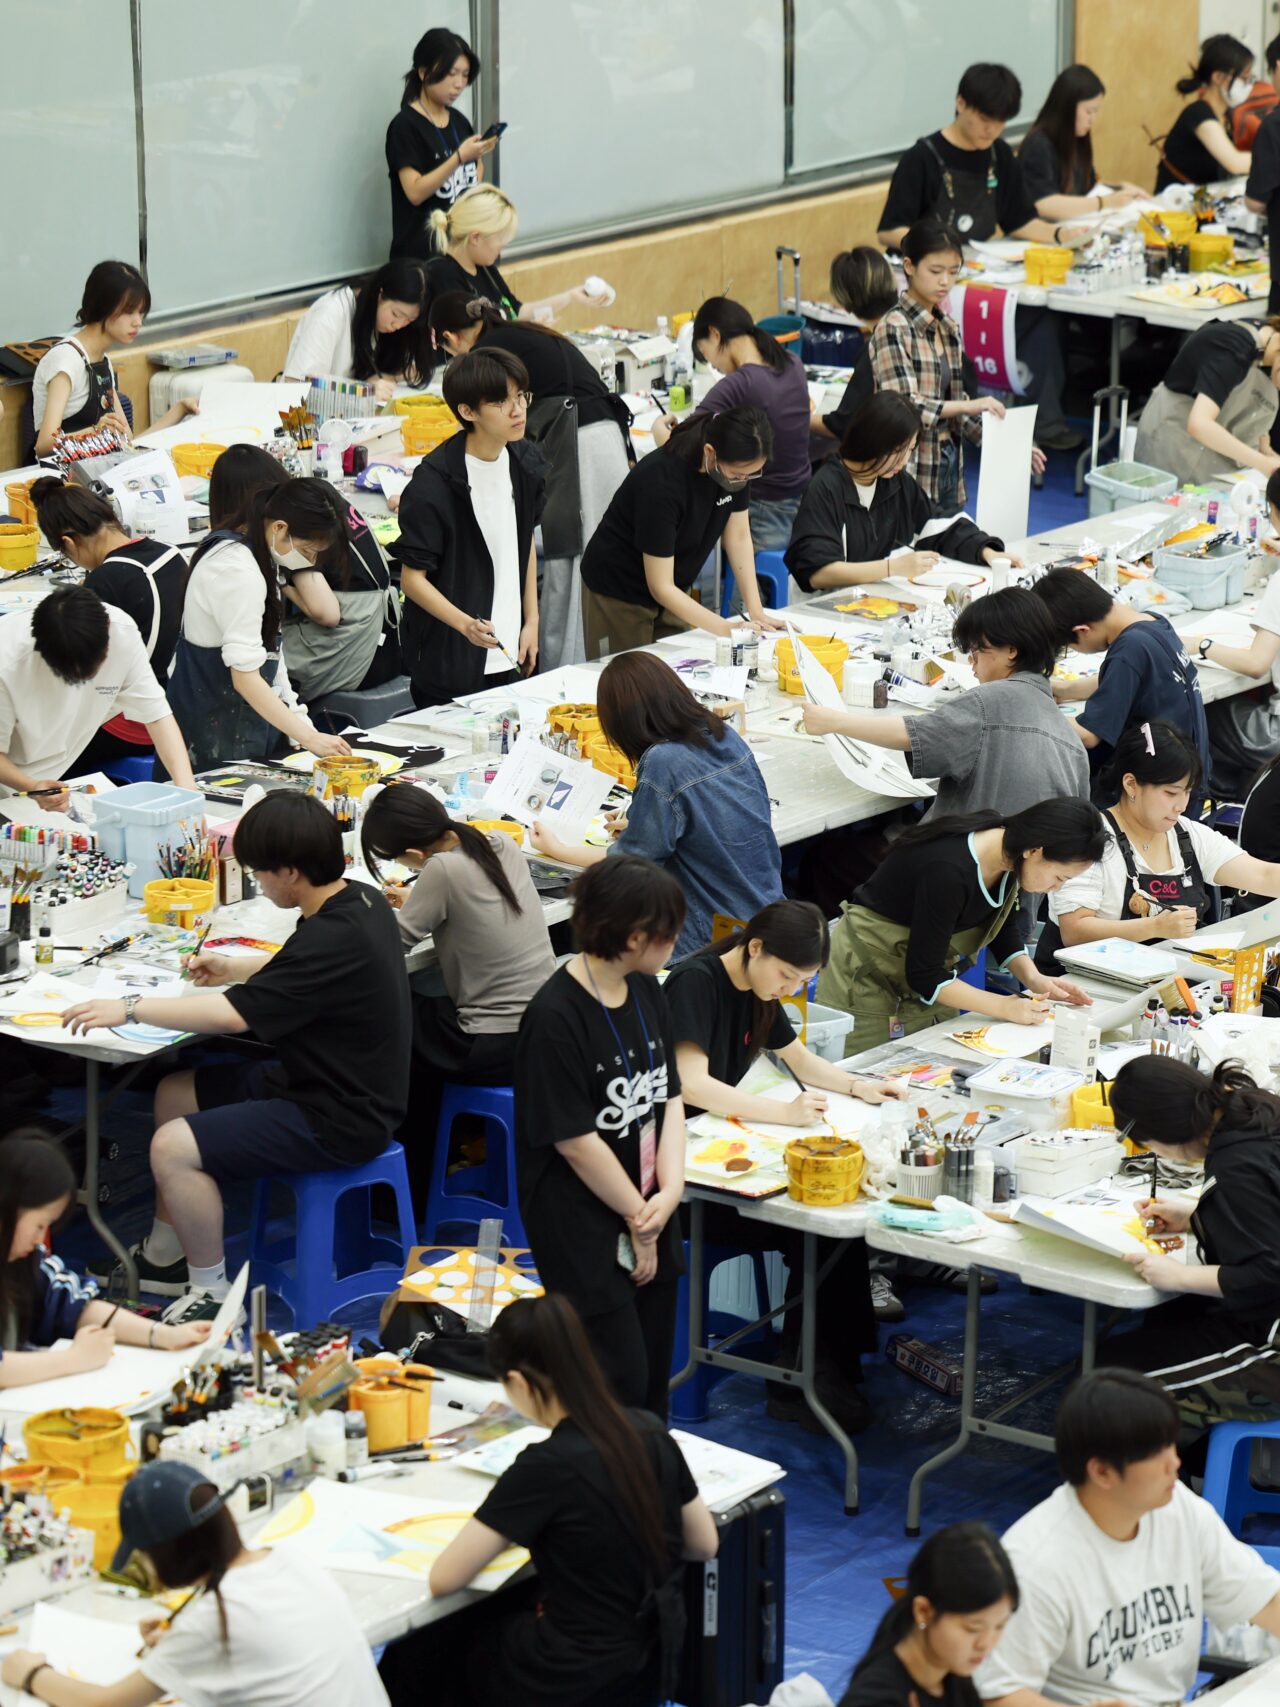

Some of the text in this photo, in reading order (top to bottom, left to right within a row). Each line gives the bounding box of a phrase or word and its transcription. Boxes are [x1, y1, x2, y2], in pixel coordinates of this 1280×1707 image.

[979, 300, 989, 320] 1
[974, 356, 998, 375] 16
[1149, 879, 1178, 895] C&C
[596, 1048, 635, 1073] ASK
[1086, 1583, 1195, 1670] COLUMBIA
